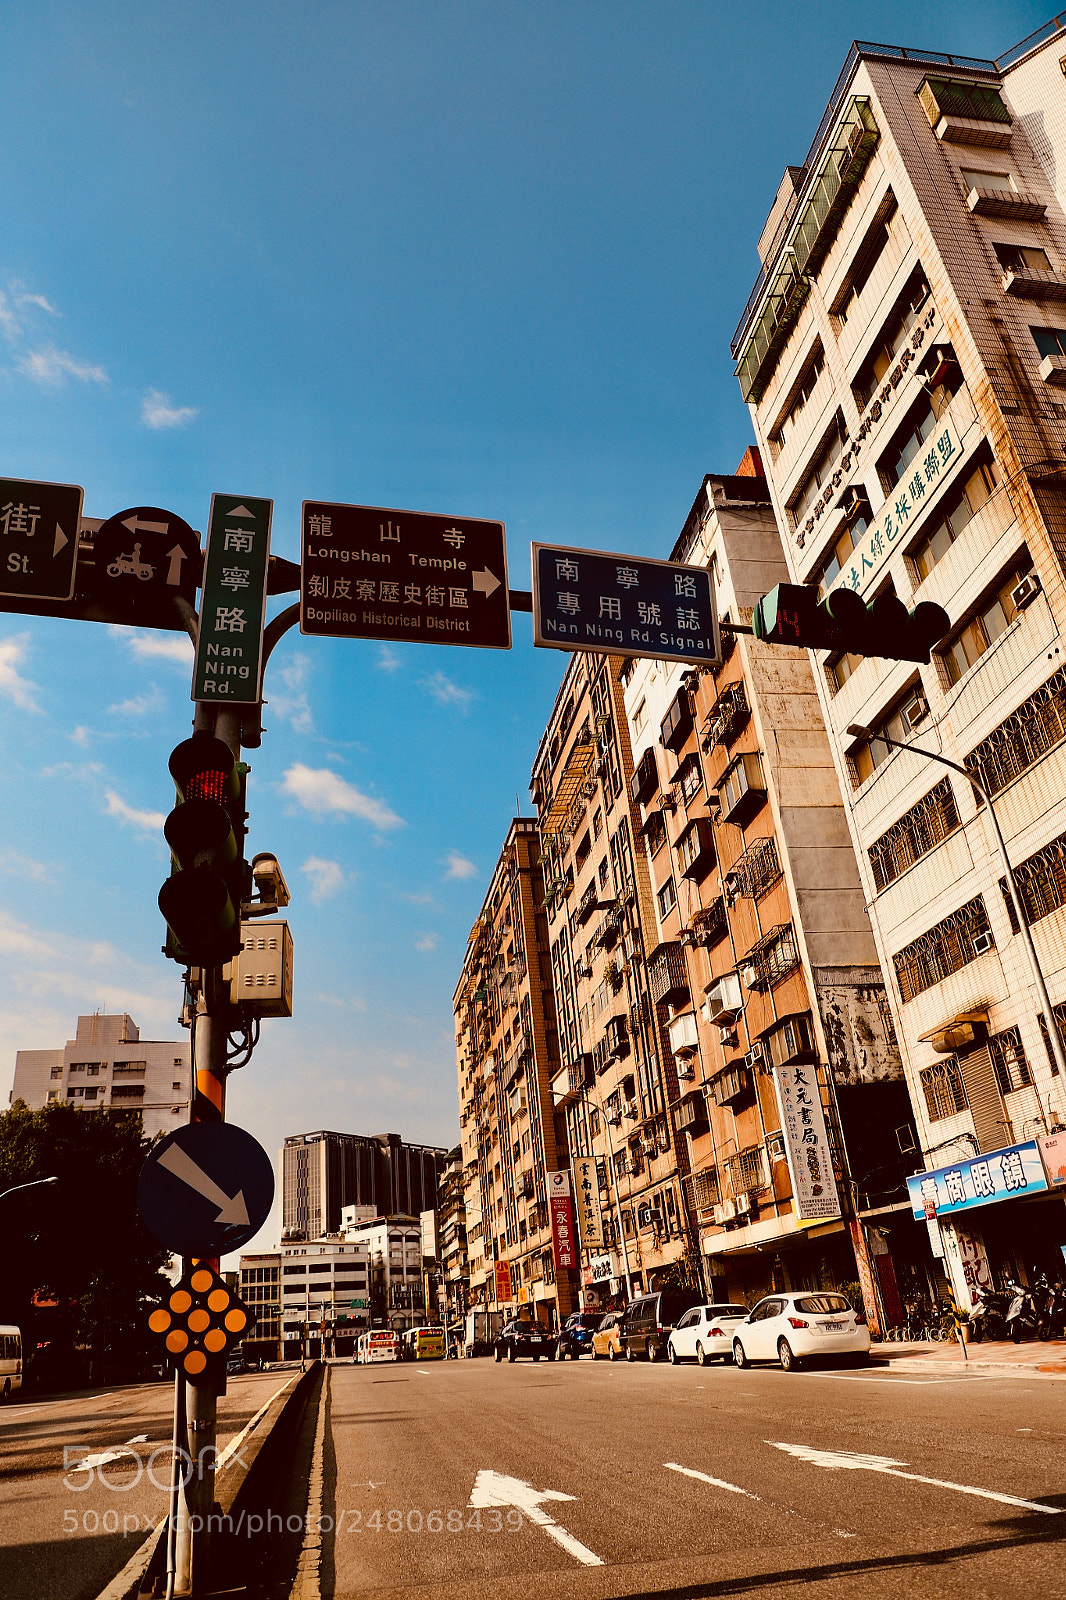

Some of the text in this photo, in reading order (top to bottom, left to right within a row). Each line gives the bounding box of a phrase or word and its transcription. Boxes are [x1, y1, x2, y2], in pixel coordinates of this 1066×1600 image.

[0, 502, 41, 537] 街
[839, 428, 957, 592] 法人綠色採購聯盟
[308, 513, 466, 549] 龍山寺
[6, 551, 34, 574] St.
[307, 544, 468, 571] Longshan Temple
[214, 527, 257, 634] 南寧路
[554, 558, 698, 599] 南寧路
[306, 607, 470, 632] Bopiliao Historical District
[555, 591, 701, 631] 專用號誌
[777, 609, 800, 637] 14
[206, 643, 243, 657] Nan
[546, 618, 711, 651] Nan Ning Rd. Signal
[203, 679, 235, 694] Rd.
[204, 660, 250, 679] Ning
[793, 1067, 819, 1145] 大元書局
[920, 1151, 1028, 1210] 青商眼鏡
[579, 1162, 598, 1237] 雲南普洱茶
[555, 1211, 572, 1267] 永春汽車
